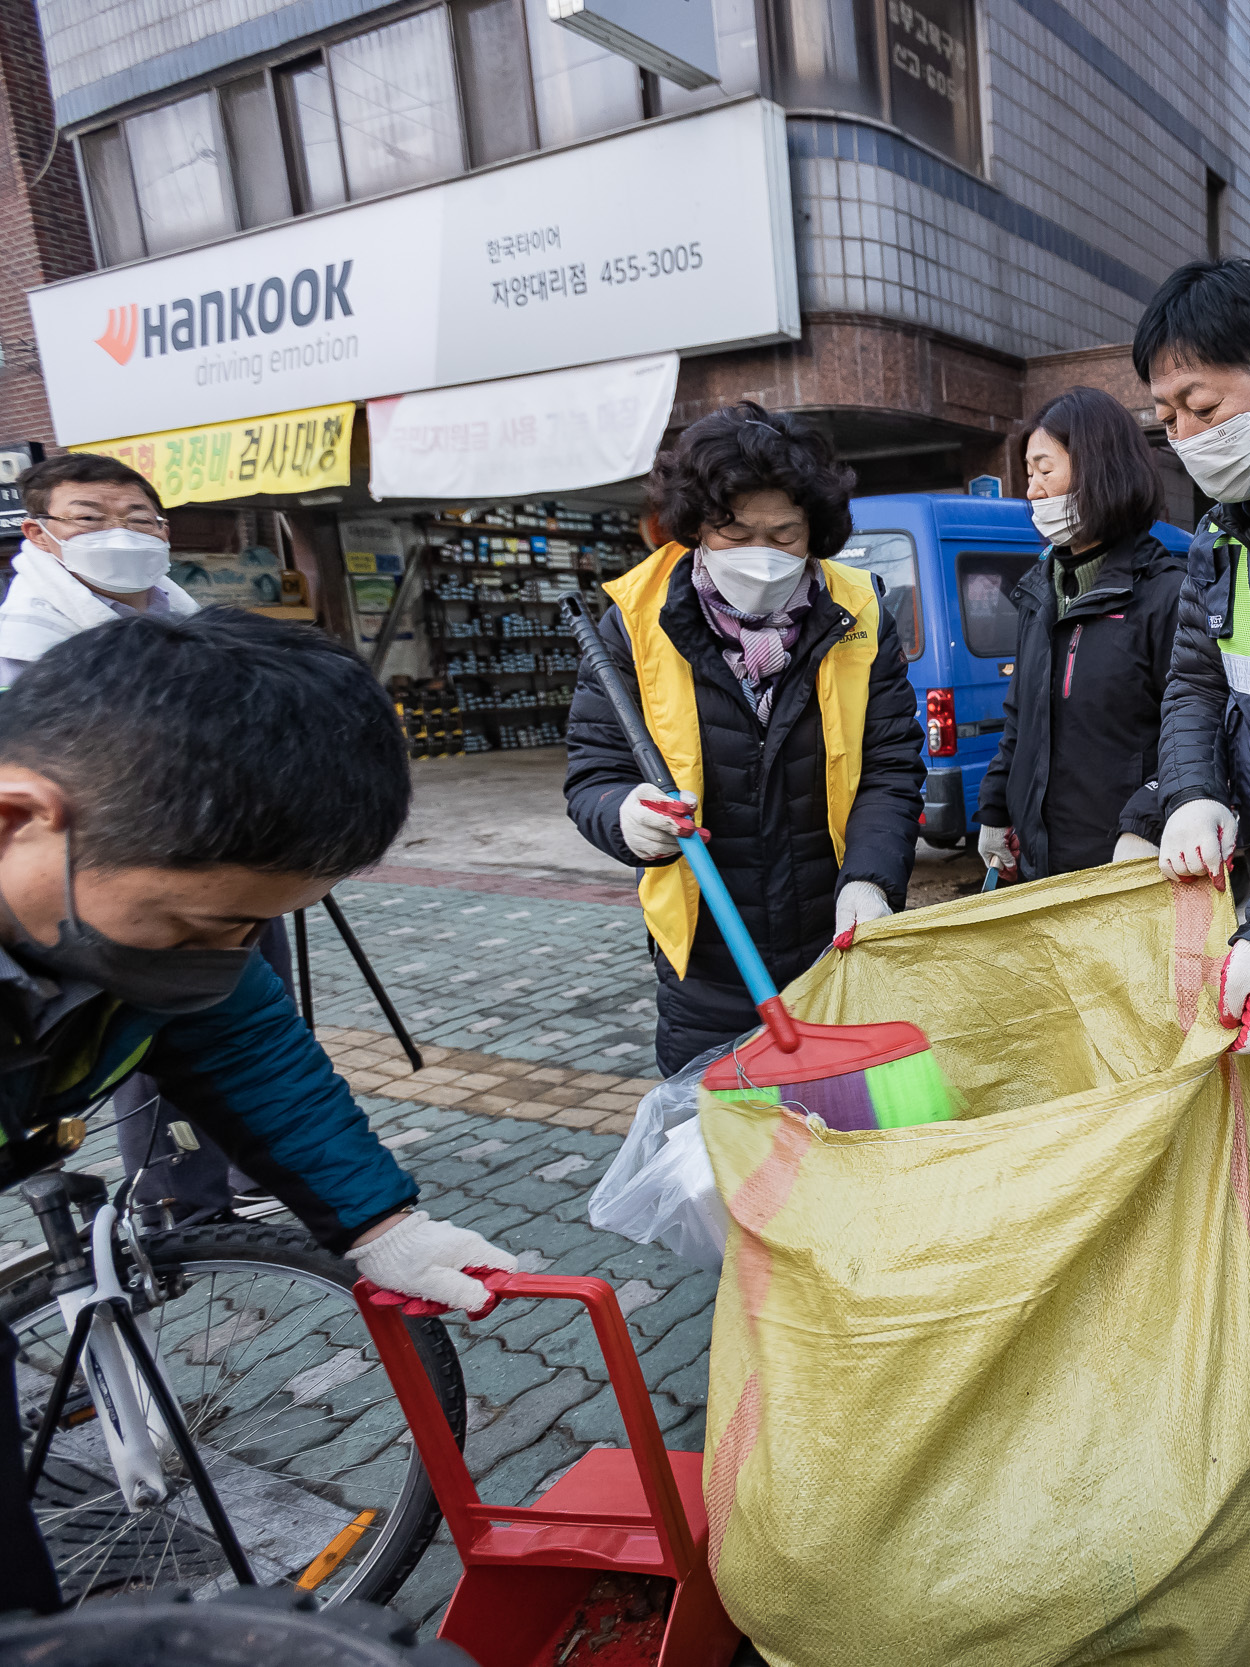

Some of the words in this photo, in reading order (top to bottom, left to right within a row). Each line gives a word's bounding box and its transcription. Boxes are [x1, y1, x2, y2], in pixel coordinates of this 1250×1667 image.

[487, 225, 562, 264] 한국타이어
[492, 263, 588, 308] 자양대리점
[600, 241, 703, 286] 455-3005
[196, 350, 262, 386] driving
[270, 332, 358, 373] emotion
[239, 414, 345, 481] 검사대행
[501, 414, 538, 447] 사용
